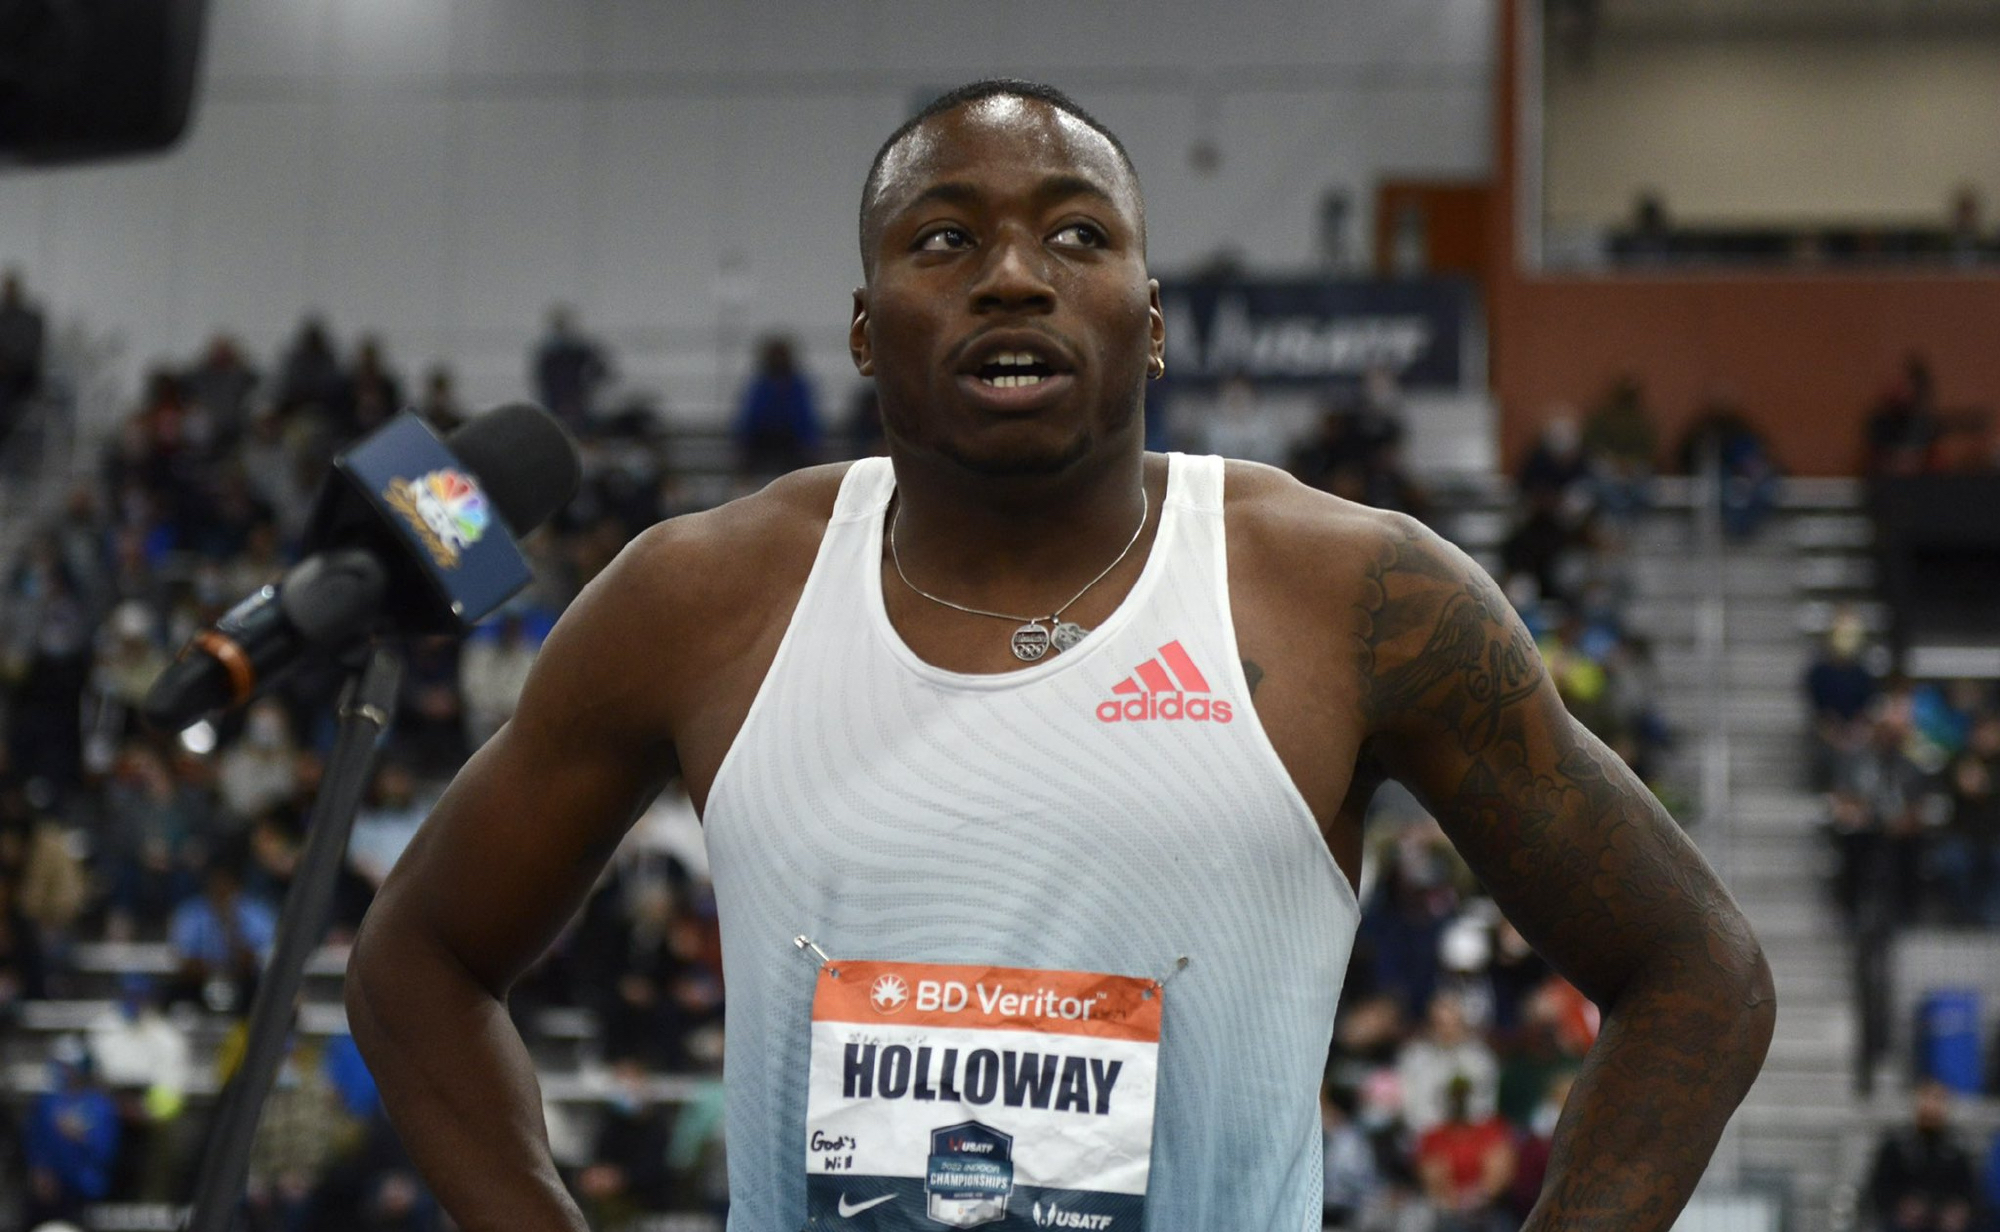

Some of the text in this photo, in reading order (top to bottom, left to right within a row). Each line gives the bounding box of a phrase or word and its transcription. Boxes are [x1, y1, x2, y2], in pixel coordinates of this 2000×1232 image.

[1096, 691, 1233, 724] adidas
[915, 980, 969, 1013] BD
[843, 1043, 1123, 1115] HOLLOWAY
[810, 1130, 856, 1152] God's
[961, 1140, 994, 1153] USATF
[930, 1172, 1008, 1189] CHAMPIONSHIPS
[1055, 1210, 1114, 1231] USATF
